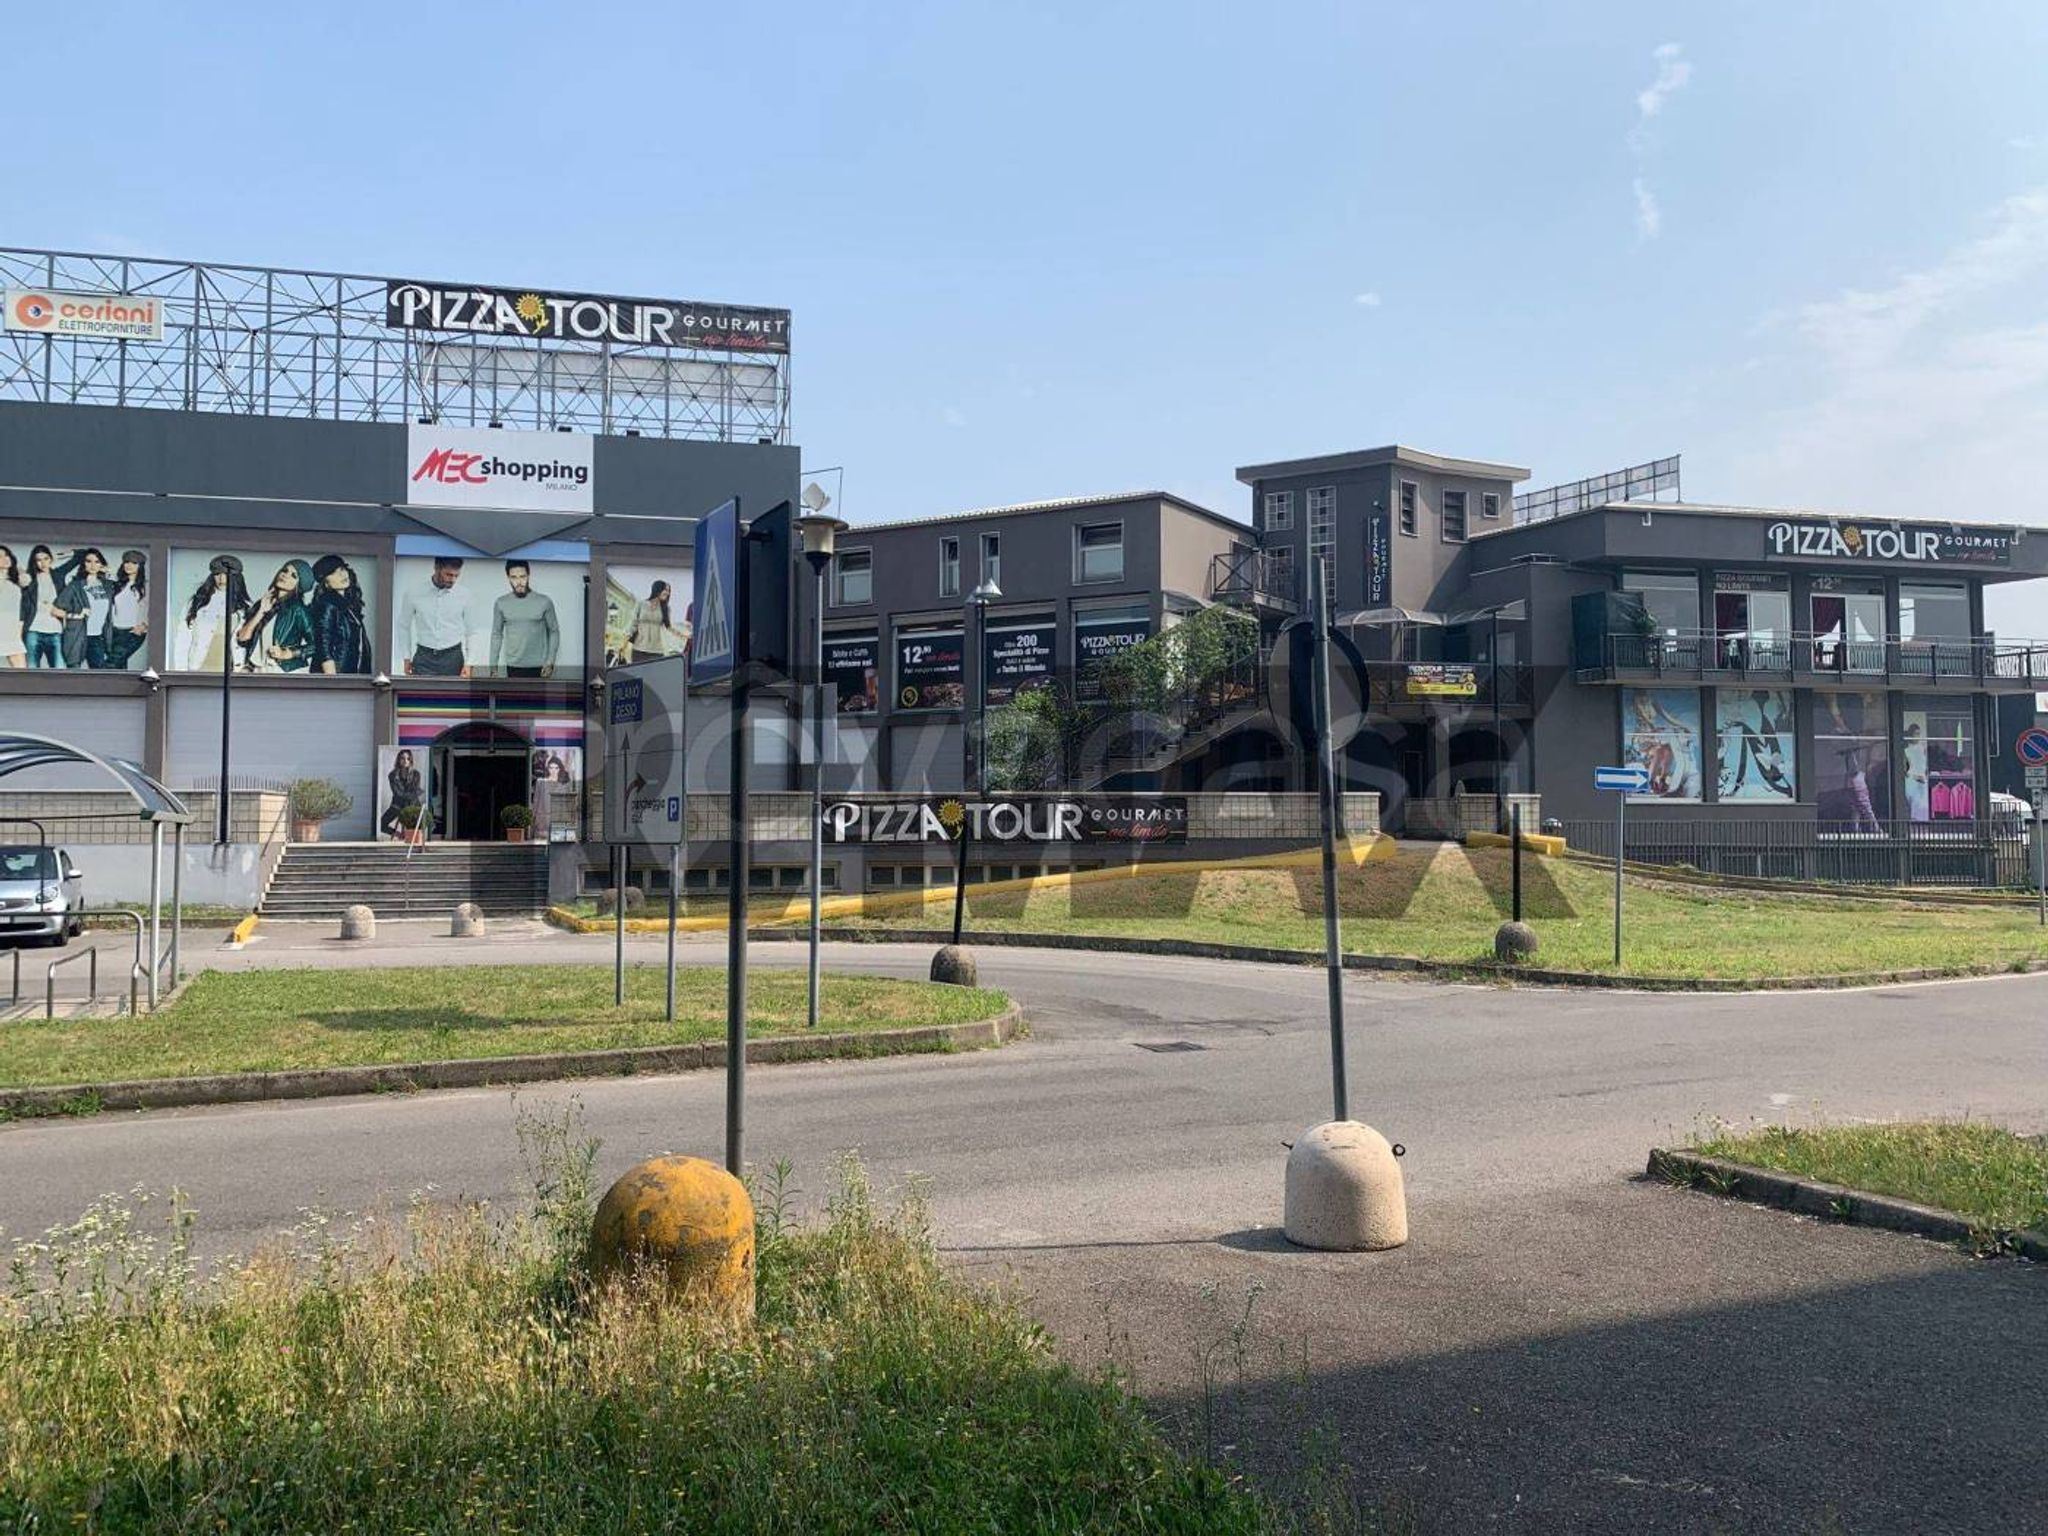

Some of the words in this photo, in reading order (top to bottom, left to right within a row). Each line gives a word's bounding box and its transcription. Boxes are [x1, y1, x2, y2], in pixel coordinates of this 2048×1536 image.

[60, 298, 154, 324] ceriani
[389, 284, 529, 335] PIZZA
[545, 299, 675, 346] TOUR
[683, 314, 786, 333] GOURMET
[58, 319, 153, 336] ELETTROFORNITURE
[481, 456, 588, 484] shopping
[545, 483, 578, 491] MILANO
[1766, 521, 1849, 557] PIZZA
[1860, 528, 1940, 561] TOUR
[1944, 535, 2007, 549] GOURMET
[1016, 633, 1038, 648] 200
[1080, 635, 1111, 649] PIZZA
[1115, 633, 1146, 646] TOUR
[822, 801, 949, 842] PIZZA
[966, 802, 1083, 841] TOUR
[1091, 808, 1186, 821] GOURMET
